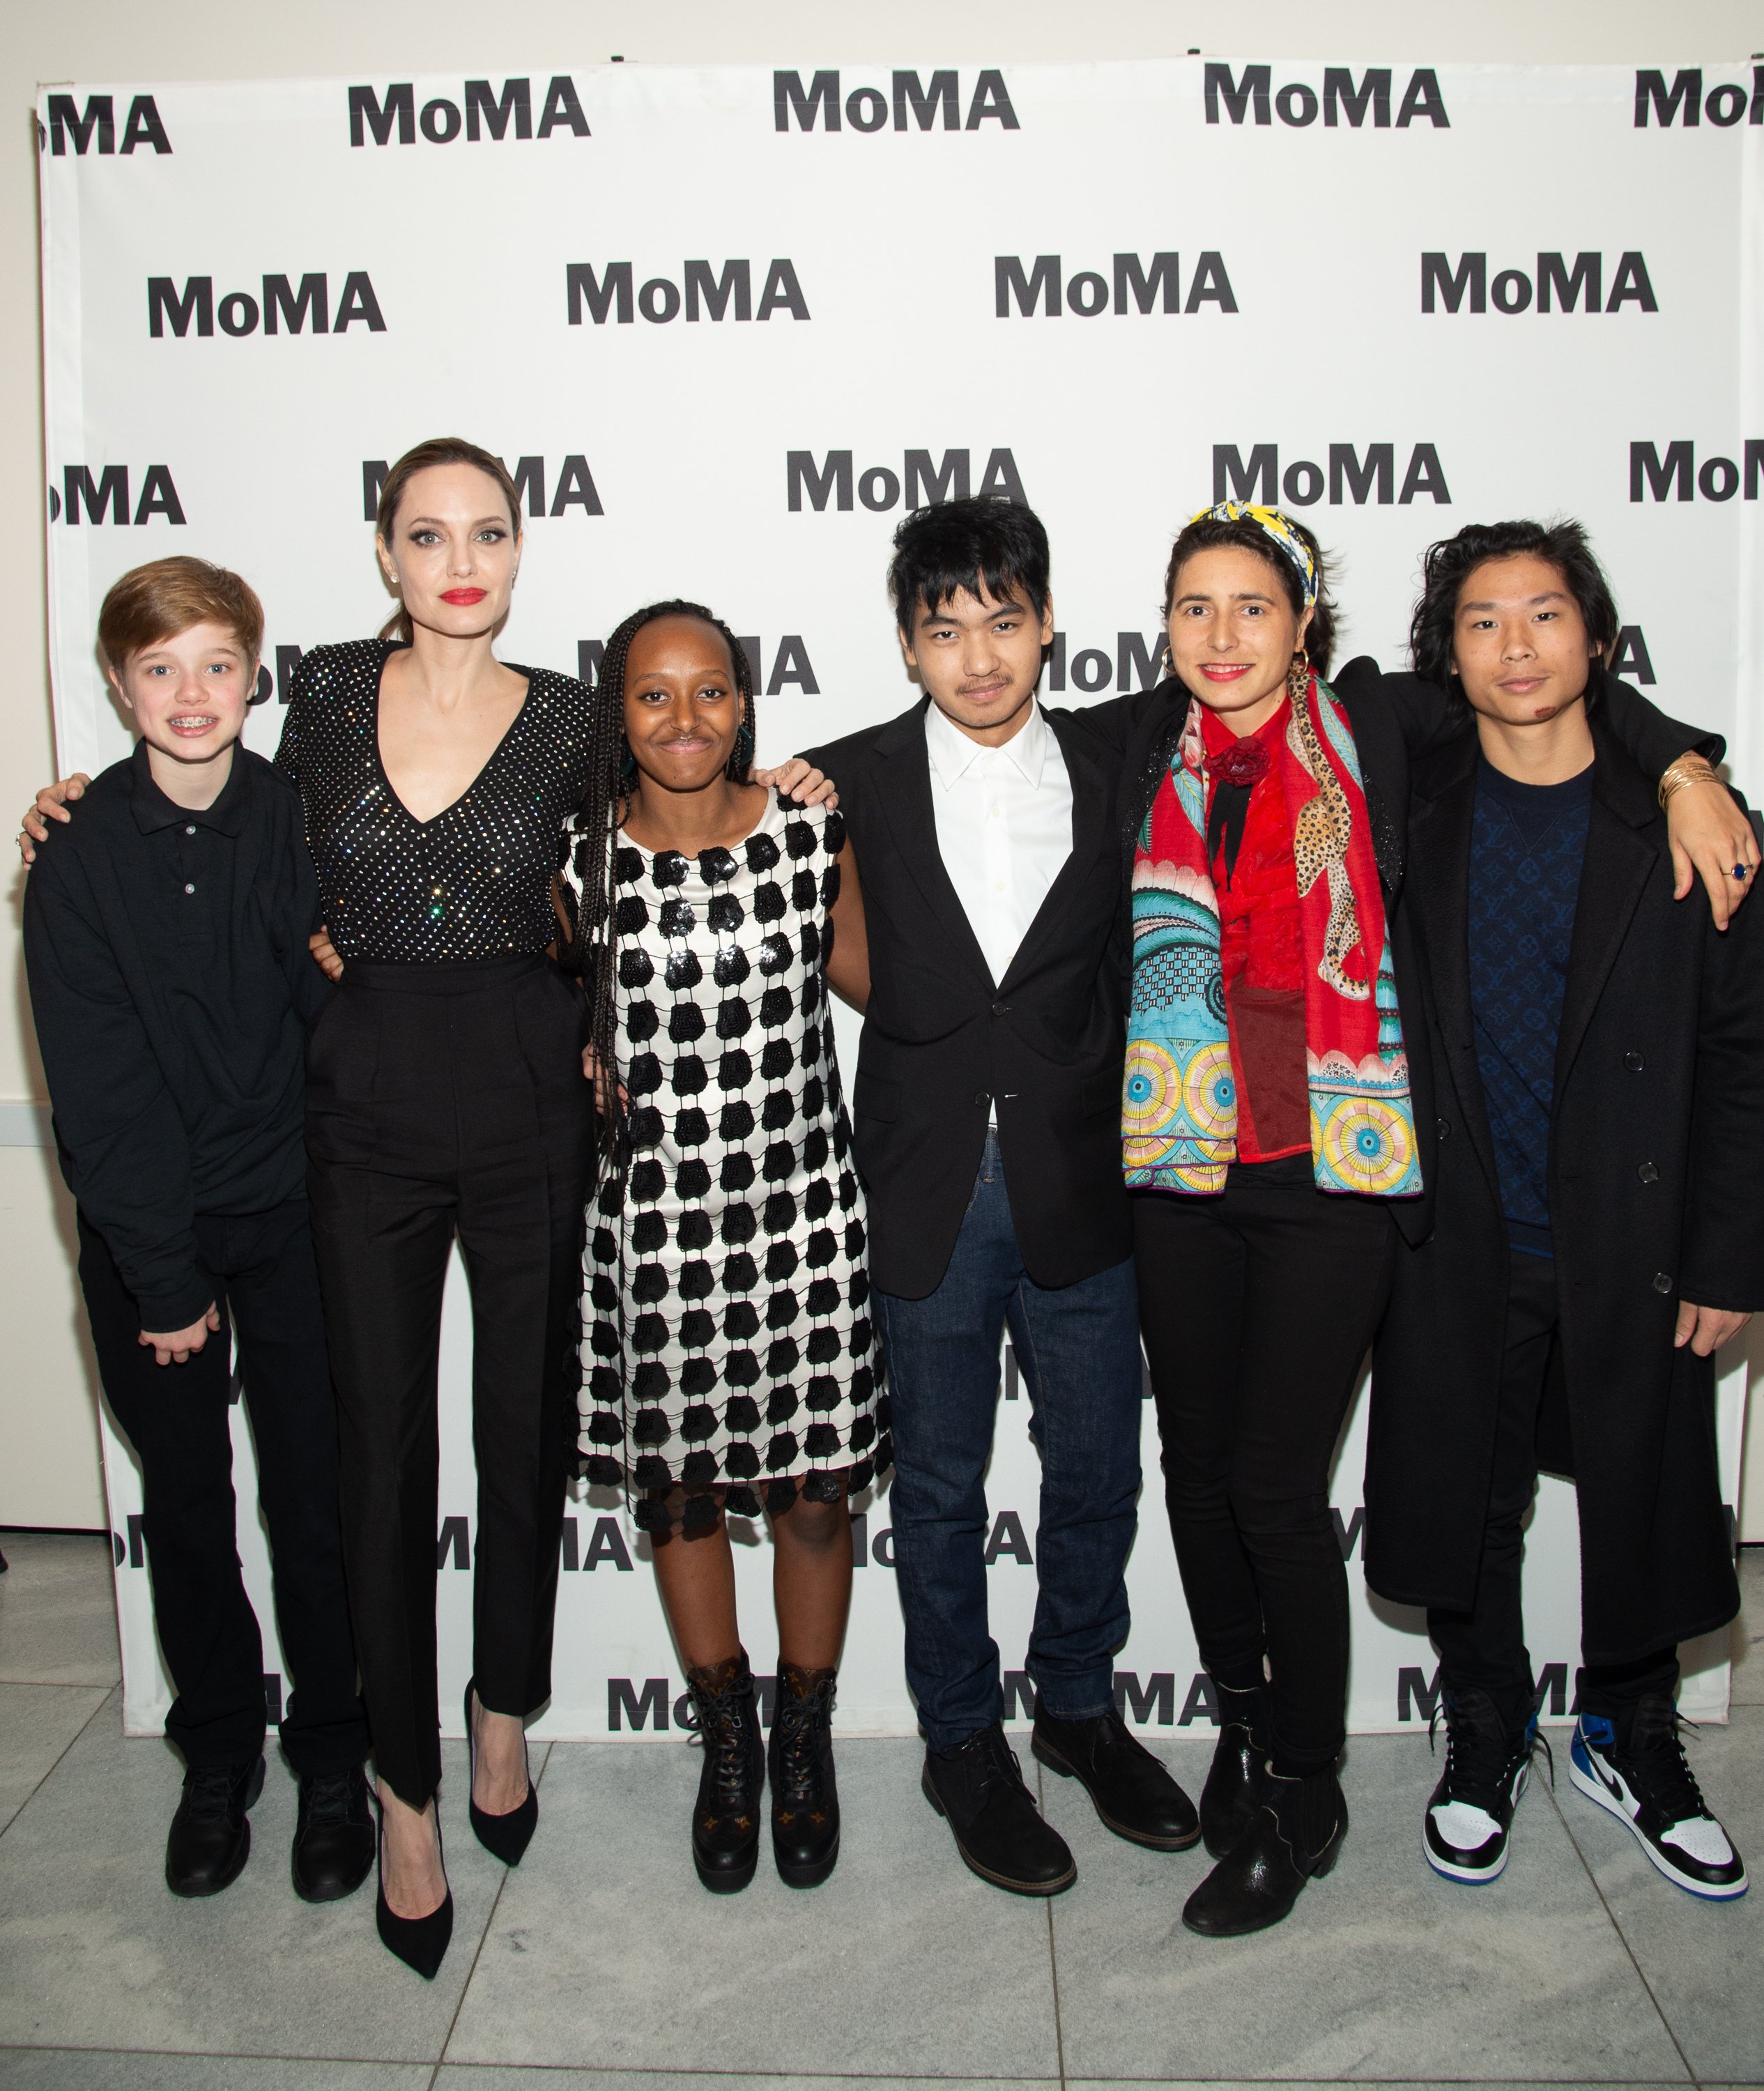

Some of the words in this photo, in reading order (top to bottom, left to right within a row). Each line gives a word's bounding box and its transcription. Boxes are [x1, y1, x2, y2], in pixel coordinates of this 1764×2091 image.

[37, 94, 173, 156] MA
[348, 76, 591, 146] MoMA
[774, 70, 1020, 132] MoMA
[1204, 63, 1450, 128] MoMA
[1634, 66, 1764, 128] Mo
[148, 271, 387, 338] MoMA
[567, 259, 811, 325] MoMA
[995, 252, 1239, 317] MoMA
[1421, 252, 1659, 314] MoMA
[49, 465, 187, 526] MA
[362, 454, 605, 521] MA
[786, 447, 1029, 512] MoMA
[1213, 443, 1452, 507] MoMA
